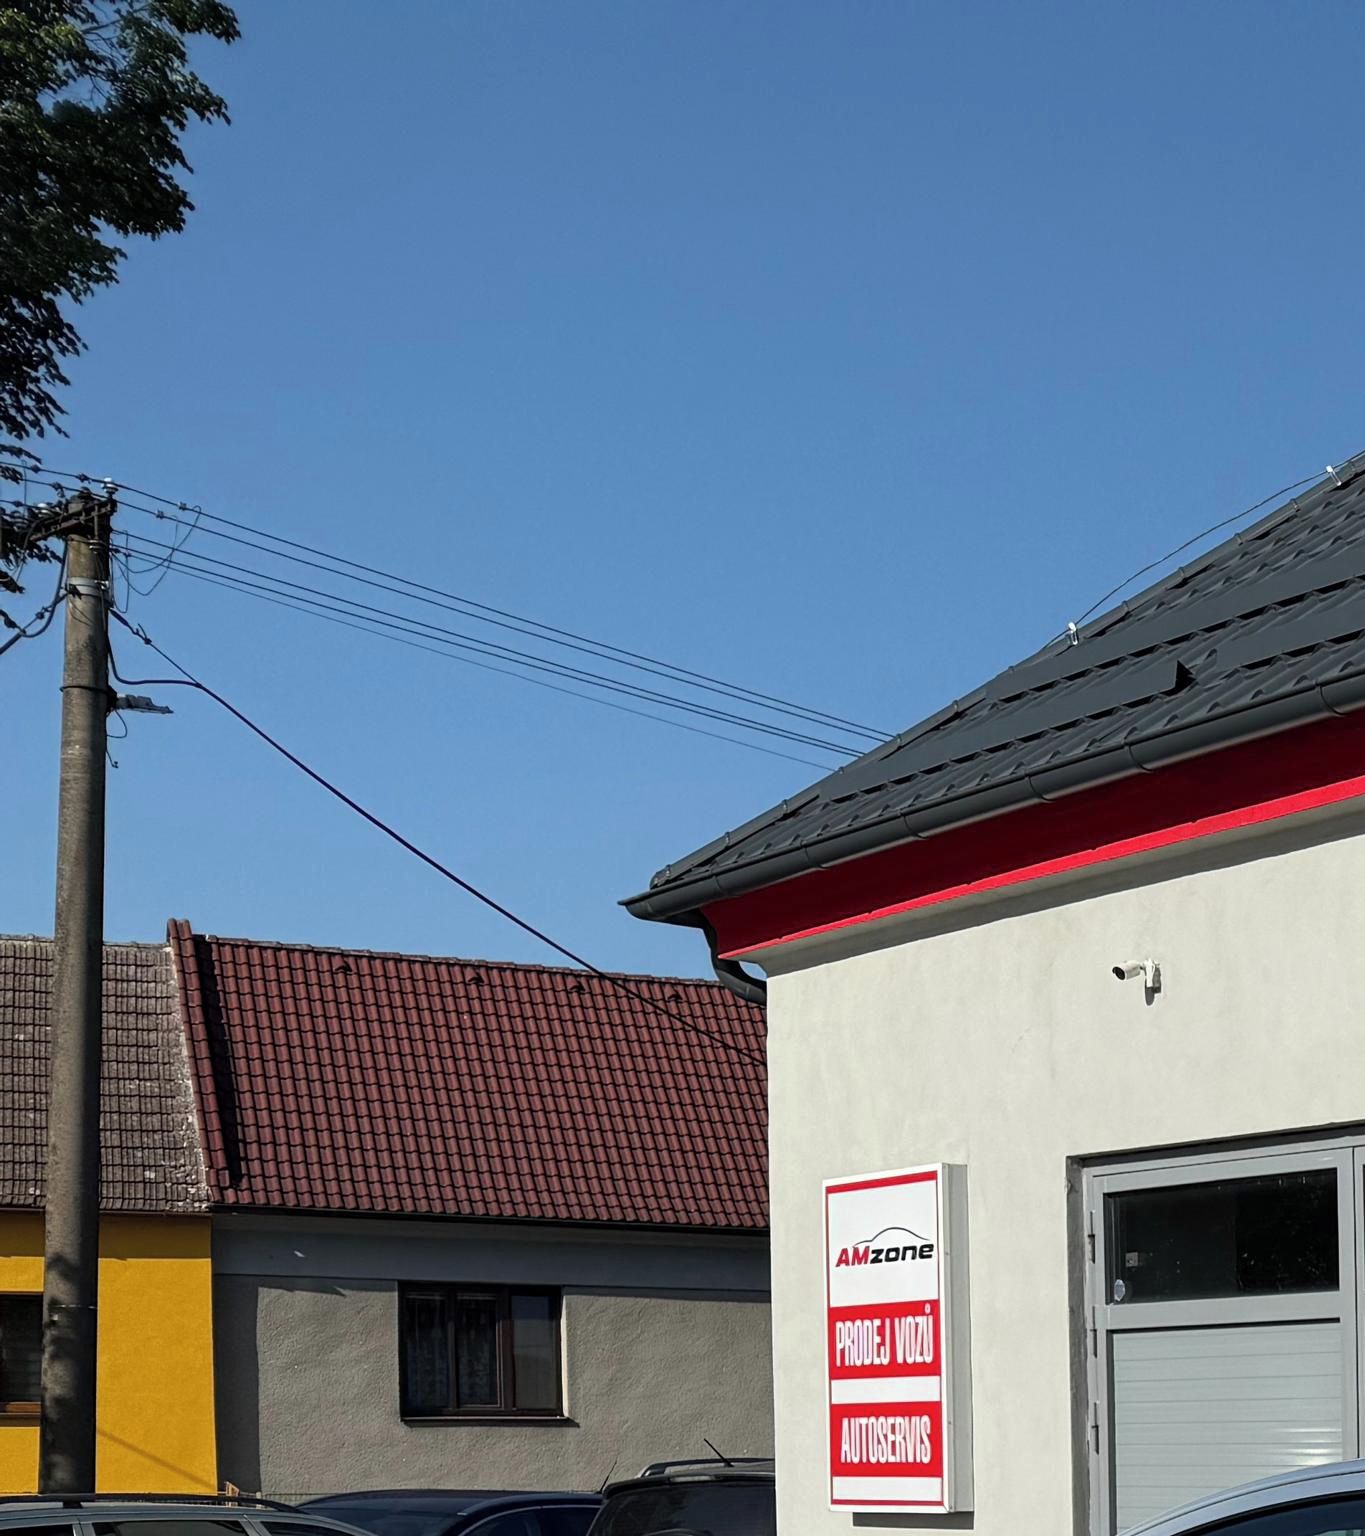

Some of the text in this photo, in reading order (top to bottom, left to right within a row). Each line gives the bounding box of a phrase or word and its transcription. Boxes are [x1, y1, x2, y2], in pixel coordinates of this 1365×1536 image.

[835, 1242, 935, 1268] AMzone
[835, 1303, 934, 1367] PRODEJ VOZŮ
[841, 1415, 931, 1465] AUTOSERVIS
